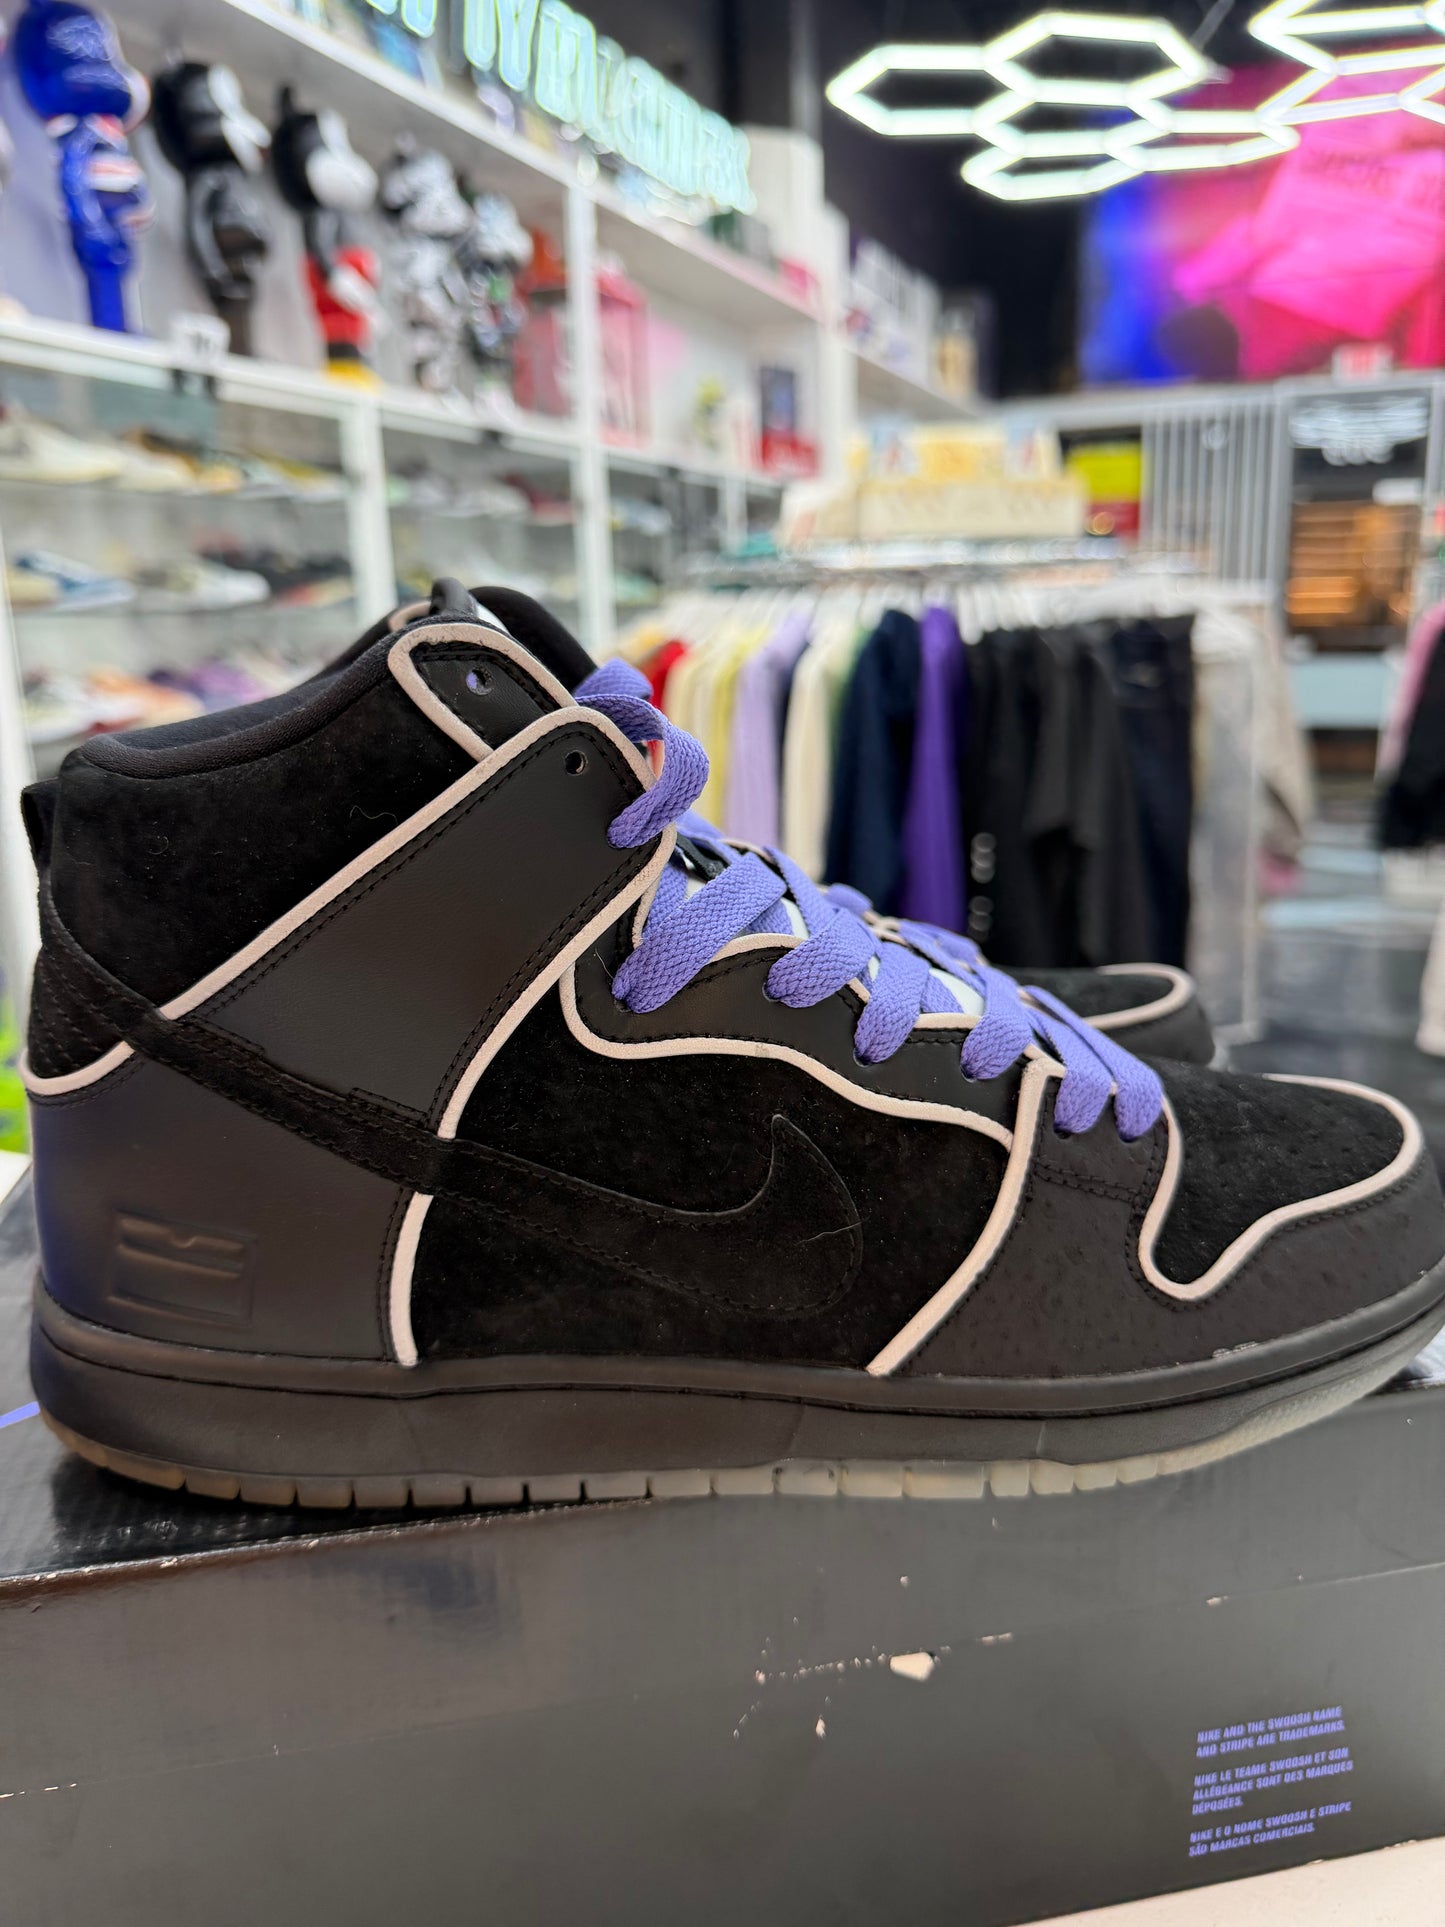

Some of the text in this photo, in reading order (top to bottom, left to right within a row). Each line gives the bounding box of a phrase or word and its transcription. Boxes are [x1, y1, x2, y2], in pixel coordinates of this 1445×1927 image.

[1197, 1721, 1344, 1757] AND STRIPE ARE TRADEMARKS.
[1198, 1706, 1342, 1742] NIKE AND THE SWOOSH NAME
[1195, 1773, 1217, 1786] NIKE
[1220, 1770, 1230, 1781] LE
[1269, 1755, 1312, 1771] SWOOSH
[1315, 1752, 1326, 1763] ET
[1329, 1748, 1348, 1760] SON
[1257, 1775, 1281, 1788] SONT
[1284, 1771, 1303, 1782] DES
[1306, 1761, 1353, 1778] MARQUES
[1191, 1802, 1351, 1842] NIKE E O NOME SWOOSH E STRIPE
[1189, 1842, 1207, 1856] SÃO
[1210, 1836, 1250, 1851] MARCAS
